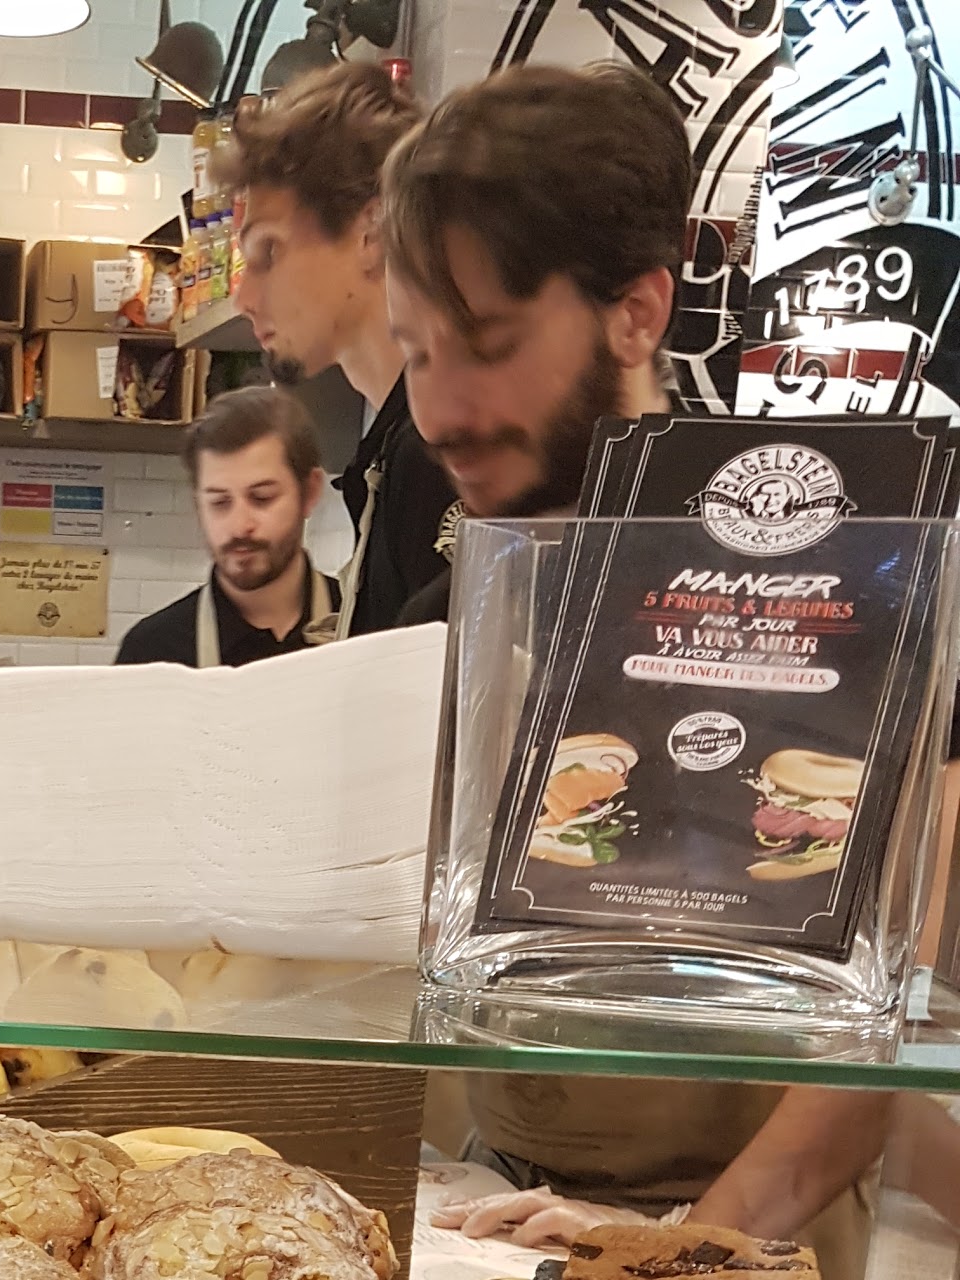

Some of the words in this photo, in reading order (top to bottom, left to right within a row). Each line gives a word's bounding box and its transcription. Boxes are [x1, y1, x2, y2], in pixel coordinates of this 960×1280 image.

[714, 449, 838, 498] BAGELSTEIN
[668, 568, 841, 600] MANGER
[643, 590, 659, 608] 5
[661, 592, 736, 613] FRUITS
[698, 613, 740, 629] PAR
[742, 617, 797, 633] JOUR
[655, 625, 683, 644] VA
[692, 628, 744, 650] VOUS
[750, 634, 819, 655] AIDER
[673, 645, 723, 661] AVOIR
[630, 659, 669, 674] POUR
[674, 662, 735, 681] MANGER
[590, 881, 639, 894] QUANTITÉS
[712, 892, 748, 905] BAGELS
[605, 892, 625, 903] PAR
[626, 895, 671, 907] PERSONNE
[682, 900, 701, 910] PAR
